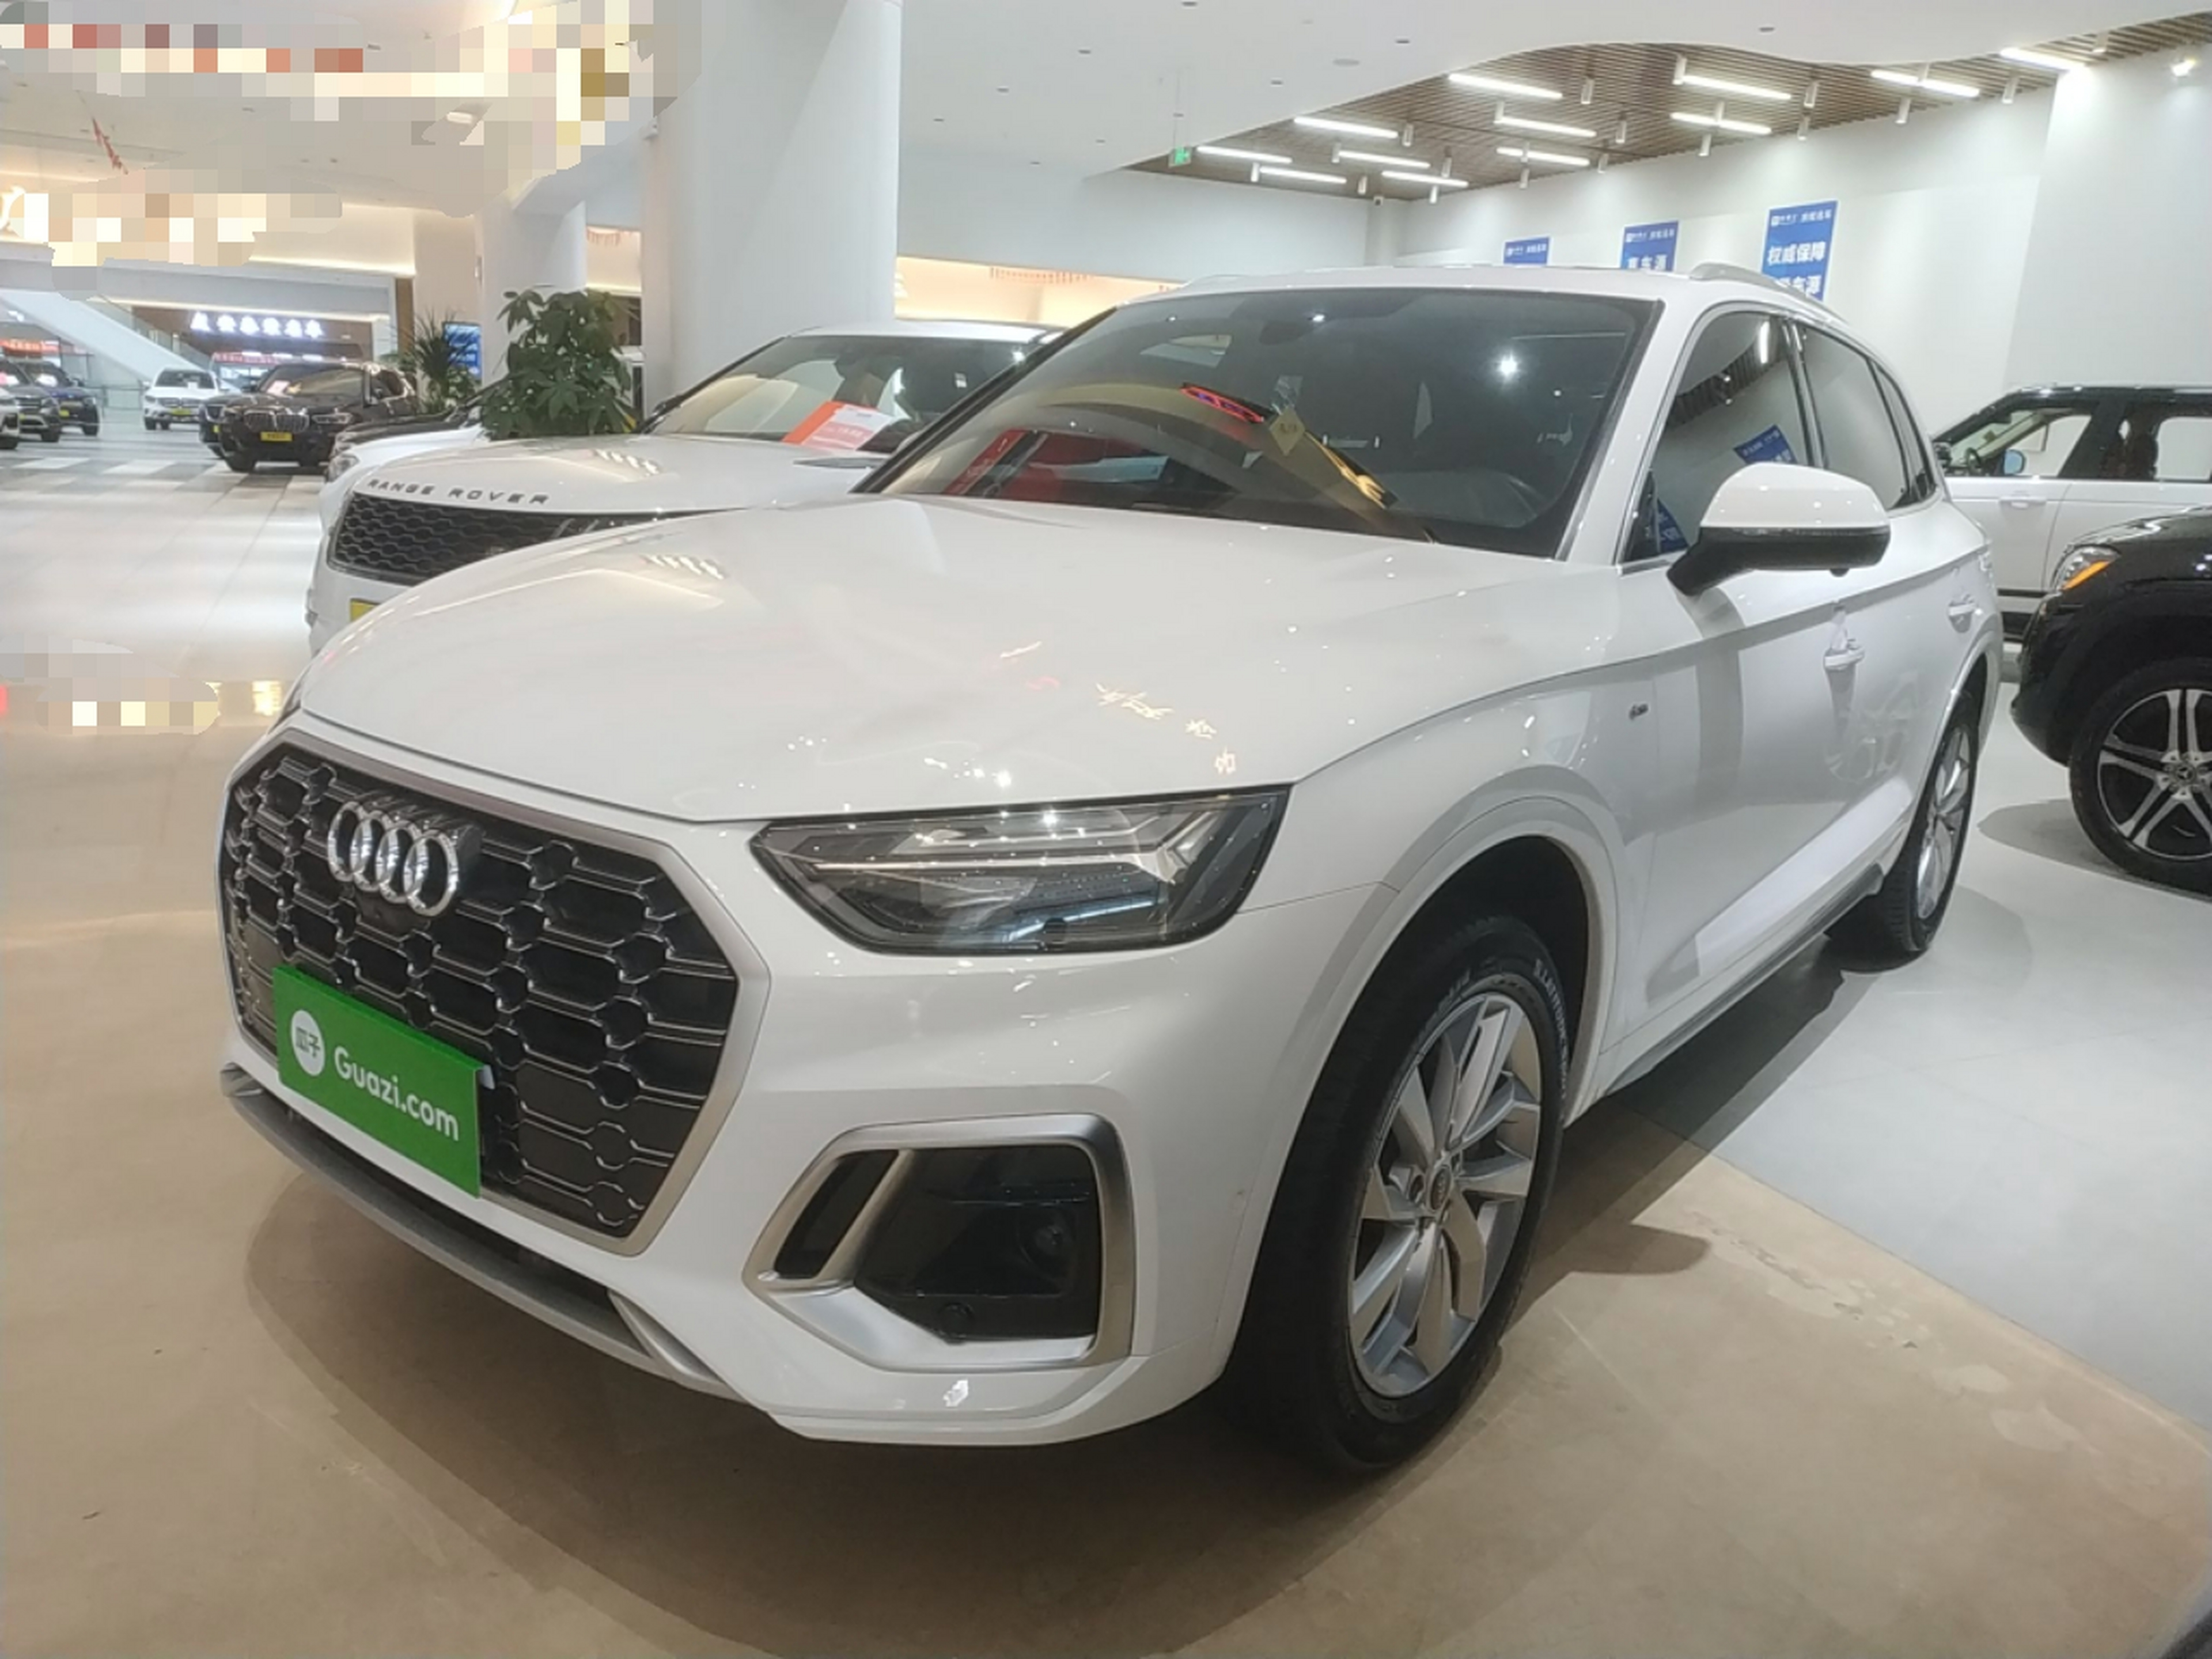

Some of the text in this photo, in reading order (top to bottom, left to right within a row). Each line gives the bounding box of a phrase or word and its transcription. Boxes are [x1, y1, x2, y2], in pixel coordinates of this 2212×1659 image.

[1767, 240, 1826, 266] 权威保障
[367, 479, 551, 505] RANGE ROVER
[334, 1046, 460, 1142] Guazi.com
